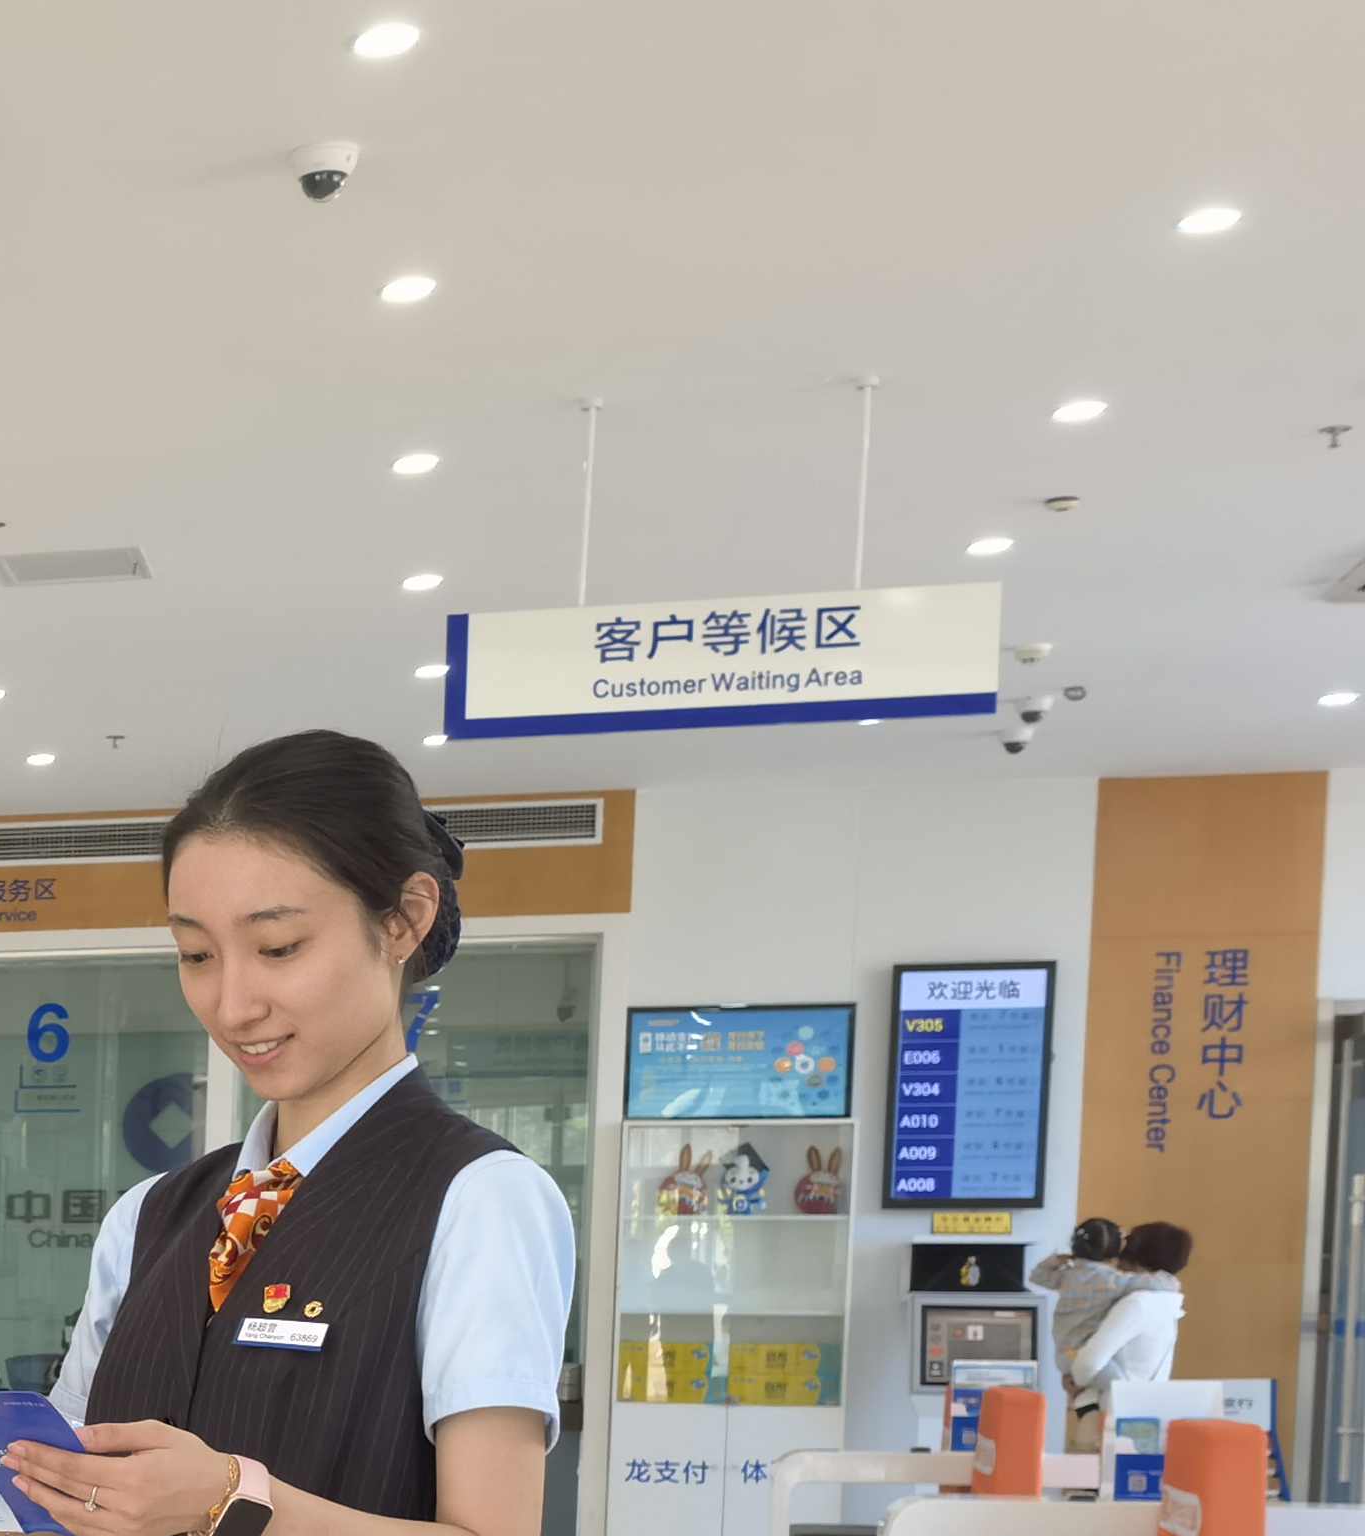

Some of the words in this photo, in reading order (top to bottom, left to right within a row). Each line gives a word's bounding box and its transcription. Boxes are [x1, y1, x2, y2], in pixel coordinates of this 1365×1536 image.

[594, 605, 861, 663] 客户等候区
[592, 674, 706, 699] Customer
[710, 669, 801, 695] Waiting
[805, 666, 863, 688] Area
[927, 980, 1020, 1000] 欢迎光临
[1150, 952, 1182, 1056] Finance
[27, 1003, 70, 1063] 6
[906, 1018, 944, 1033] V305
[1197, 949, 1249, 1119] 理财中心
[903, 1051, 940, 1065] E006
[902, 1082, 940, 1097] V304
[1146, 1063, 1176, 1153] Center
[900, 1114, 939, 1129] A010
[899, 1146, 936, 1160] A009
[897, 1178, 934, 1192] A008
[28, 1229, 92, 1248] China
[625, 1459, 709, 1484] 龙支付
[741, 1459, 767, 1484] 体
